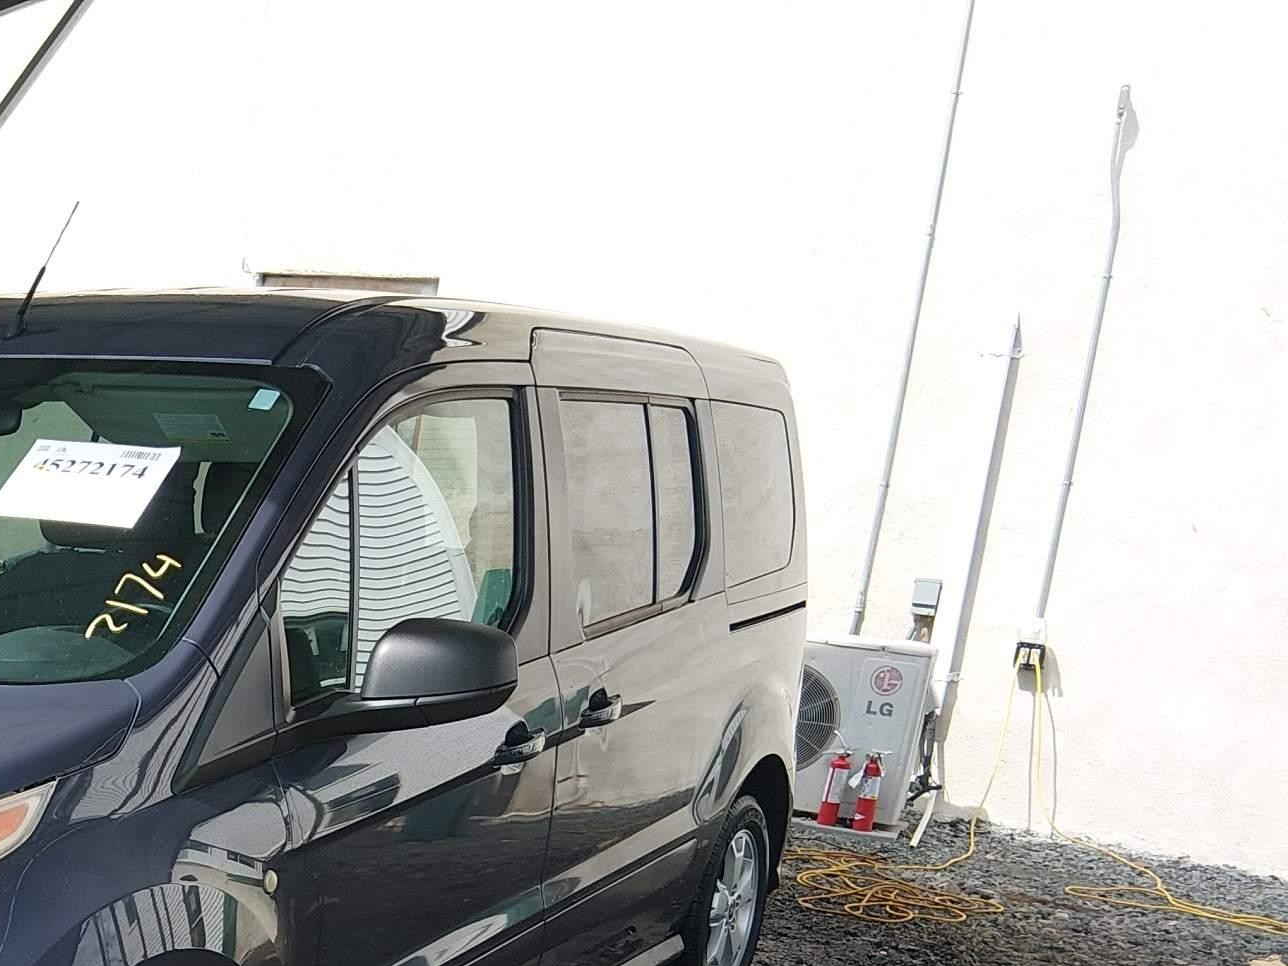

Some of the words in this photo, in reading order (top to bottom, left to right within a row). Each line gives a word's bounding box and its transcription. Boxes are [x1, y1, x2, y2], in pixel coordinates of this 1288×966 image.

[32, 458, 150, 479] 45272174
[85, 554, 182, 640] 2174
[865, 700, 894, 717] LG
